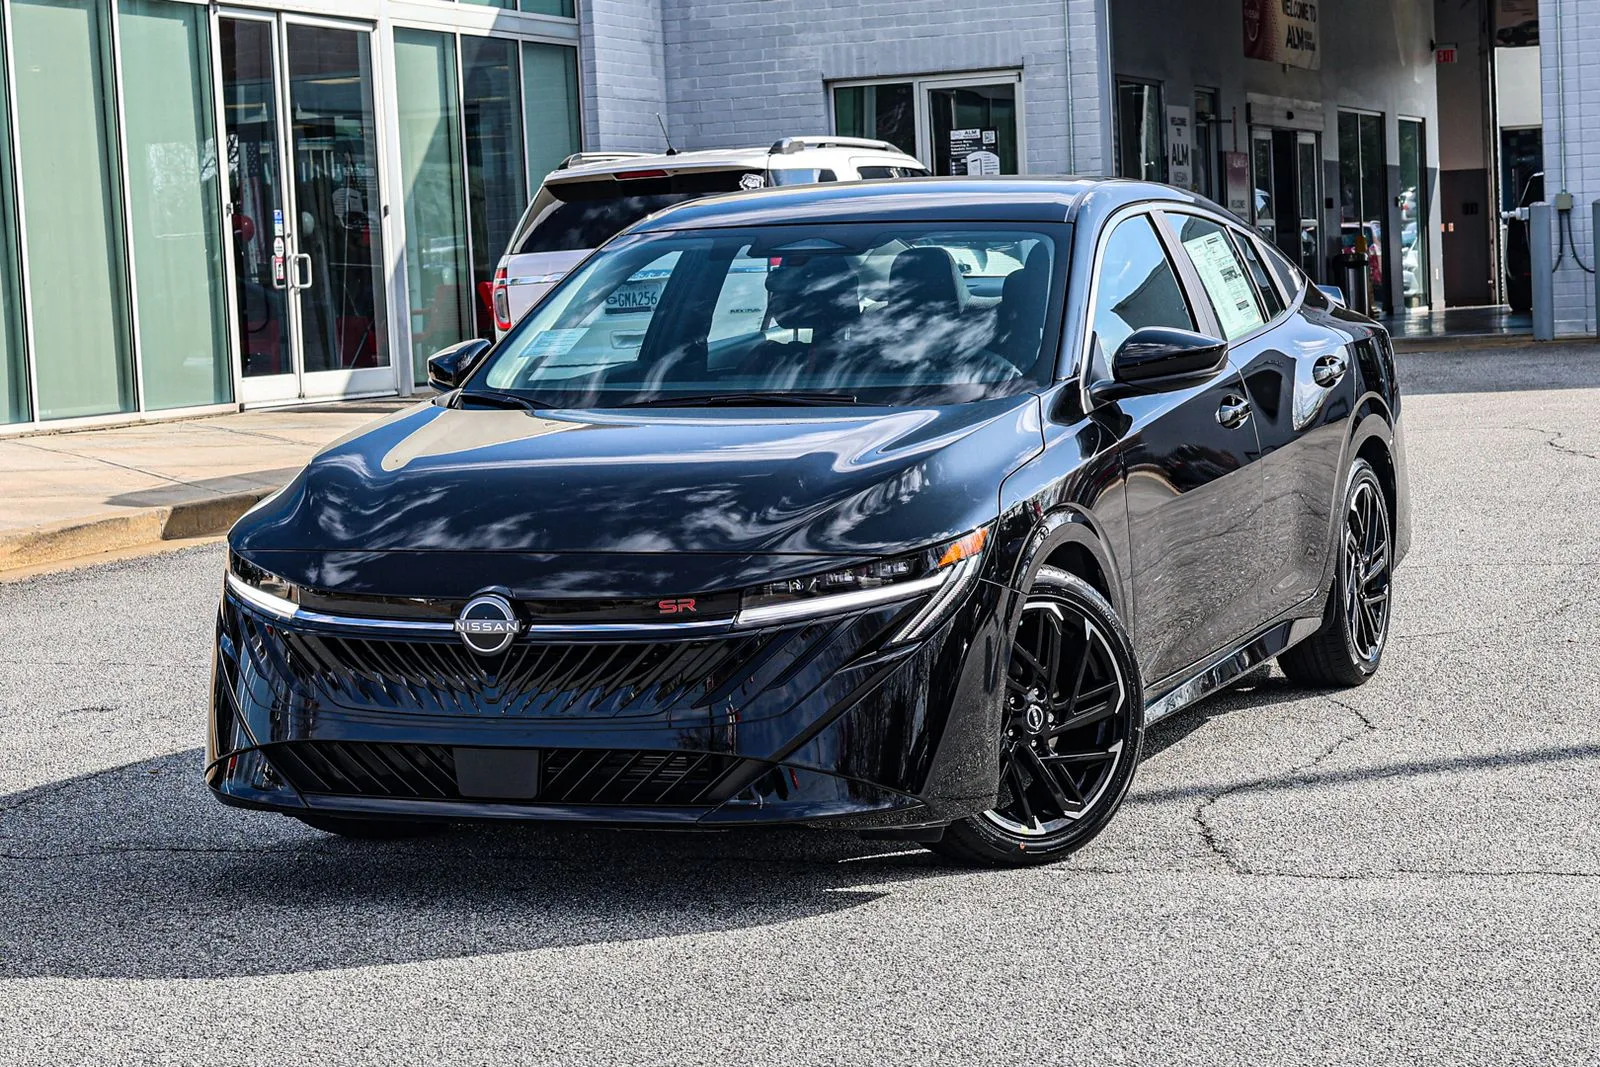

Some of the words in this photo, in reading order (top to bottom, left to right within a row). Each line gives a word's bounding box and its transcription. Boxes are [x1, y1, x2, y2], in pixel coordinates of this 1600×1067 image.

[1285, 24, 1304, 51] ALM
[1437, 49, 1455, 63] EXIT
[1171, 143, 1189, 166] ALM
[658, 598, 697, 614] SR
[456, 622, 517, 631] NISSAN
